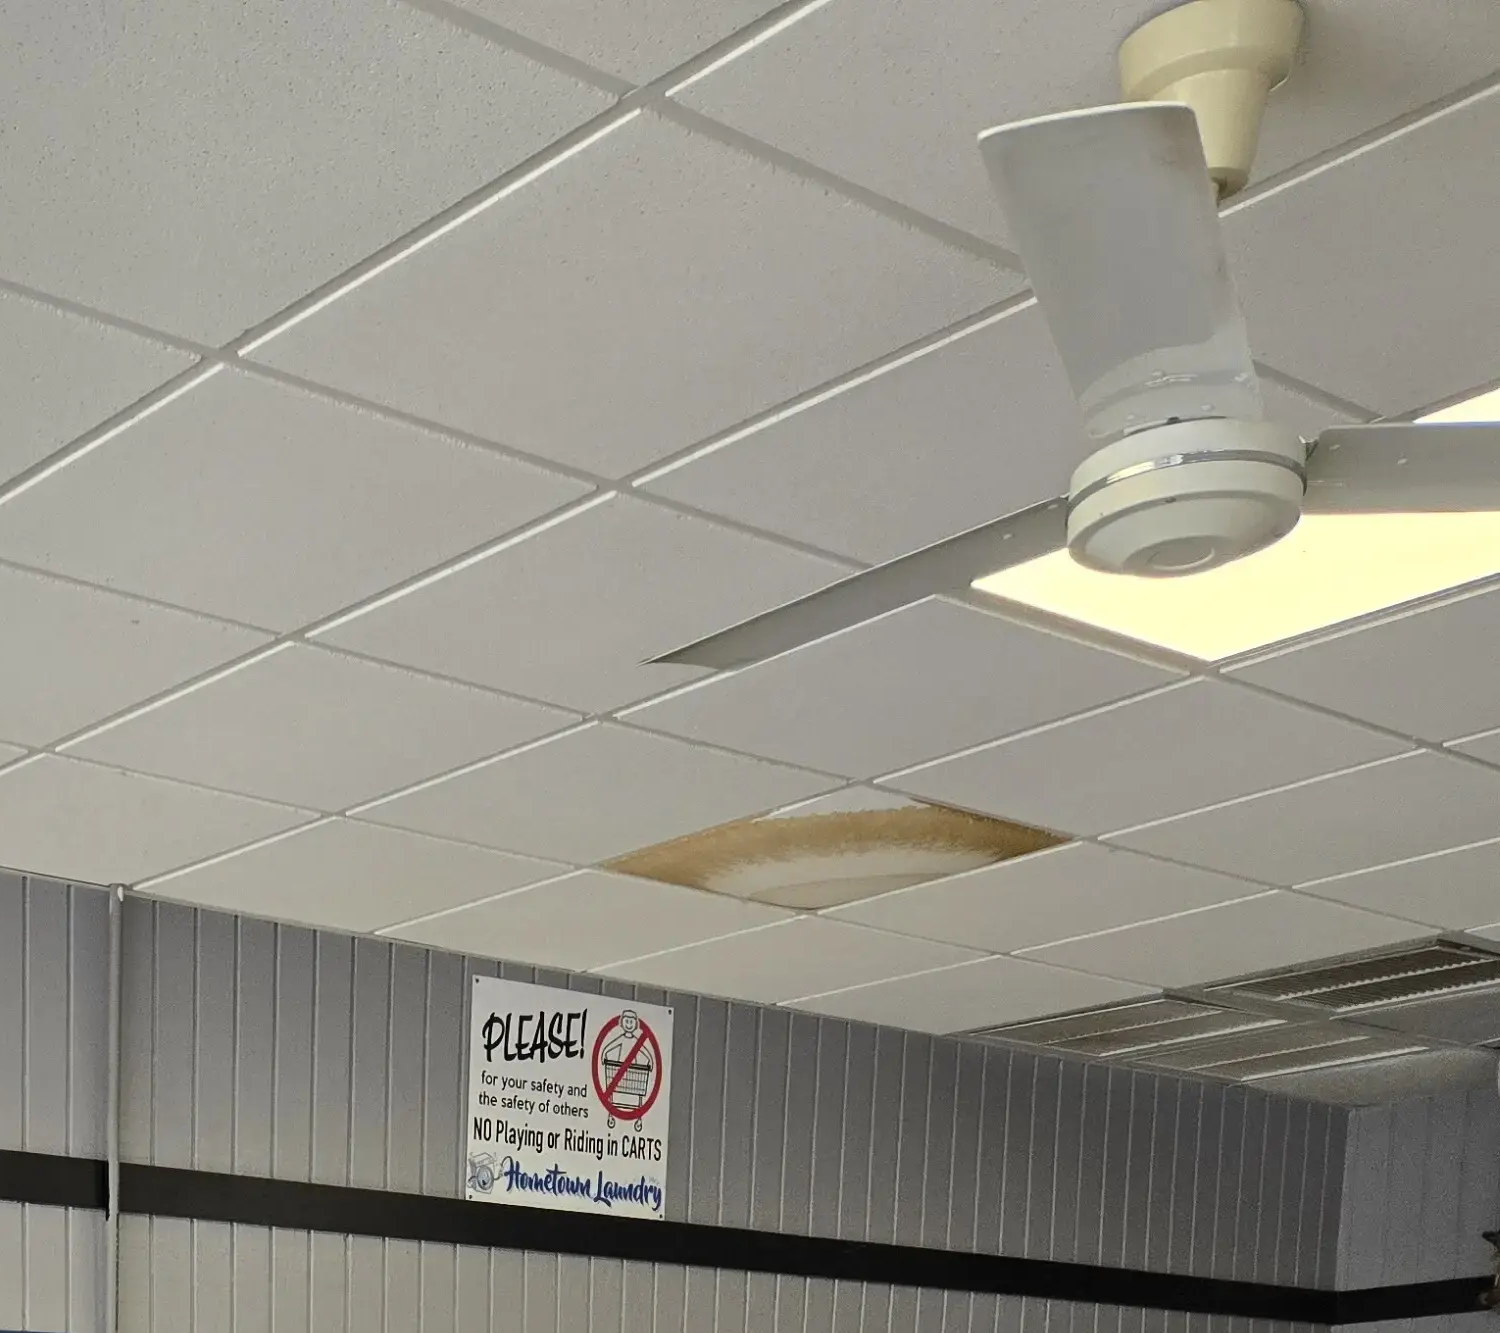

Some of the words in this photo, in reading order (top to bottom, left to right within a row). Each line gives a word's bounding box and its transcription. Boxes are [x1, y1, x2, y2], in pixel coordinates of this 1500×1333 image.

[481, 1008, 588, 1063] PLEASE!
[478, 1091, 498, 1107] the
[501, 1095, 535, 1115] safety
[538, 1099, 552, 1113] of
[553, 1102, 589, 1119] others
[481, 1070, 498, 1087] for
[501, 1075, 528, 1091] your
[530, 1078, 565, 1098] safety
[567, 1084, 587, 1098] and
[473, 1116, 492, 1142] NO
[496, 1119, 544, 1154] Playing
[547, 1130, 561, 1150] or
[564, 1127, 604, 1160] Riding
[607, 1133, 618, 1157] in
[621, 1135, 662, 1162] CARTS
[501, 1155, 591, 1199] Hometown
[593, 1170, 663, 1212] Laundry
